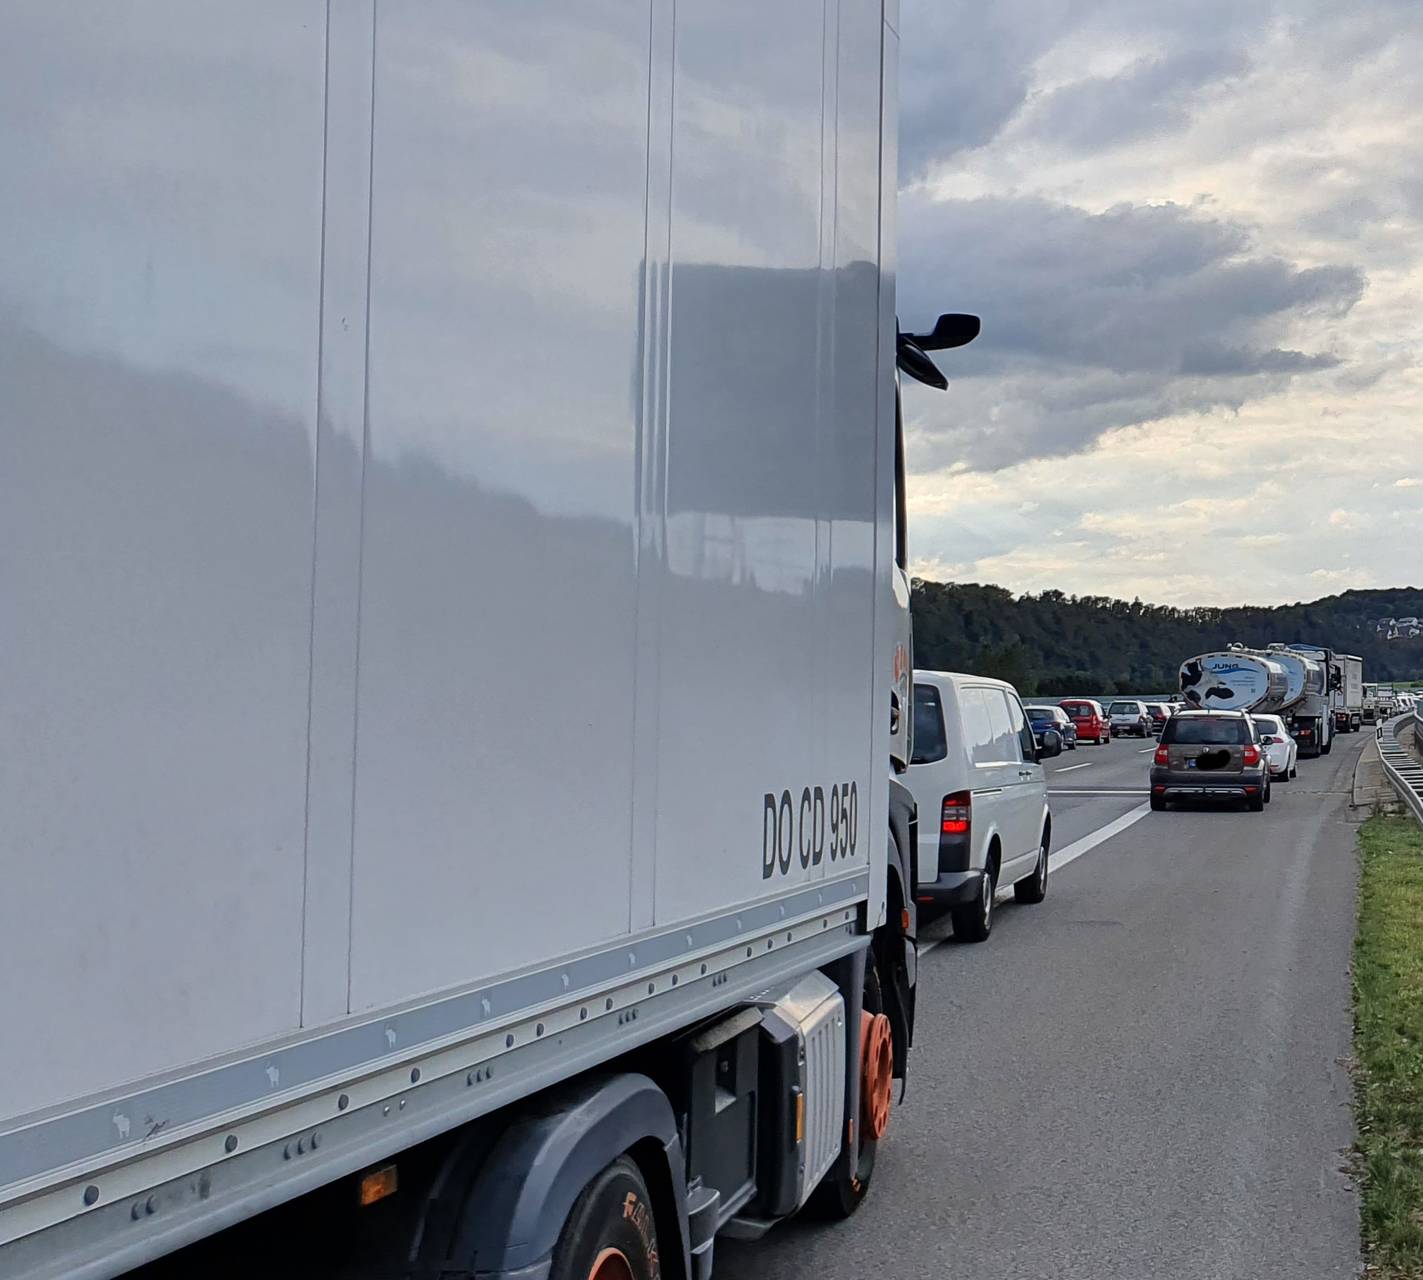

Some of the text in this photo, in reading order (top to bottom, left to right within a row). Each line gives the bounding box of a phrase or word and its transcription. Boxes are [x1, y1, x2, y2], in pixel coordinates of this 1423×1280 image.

[763, 780, 857, 879] DO CD 950
